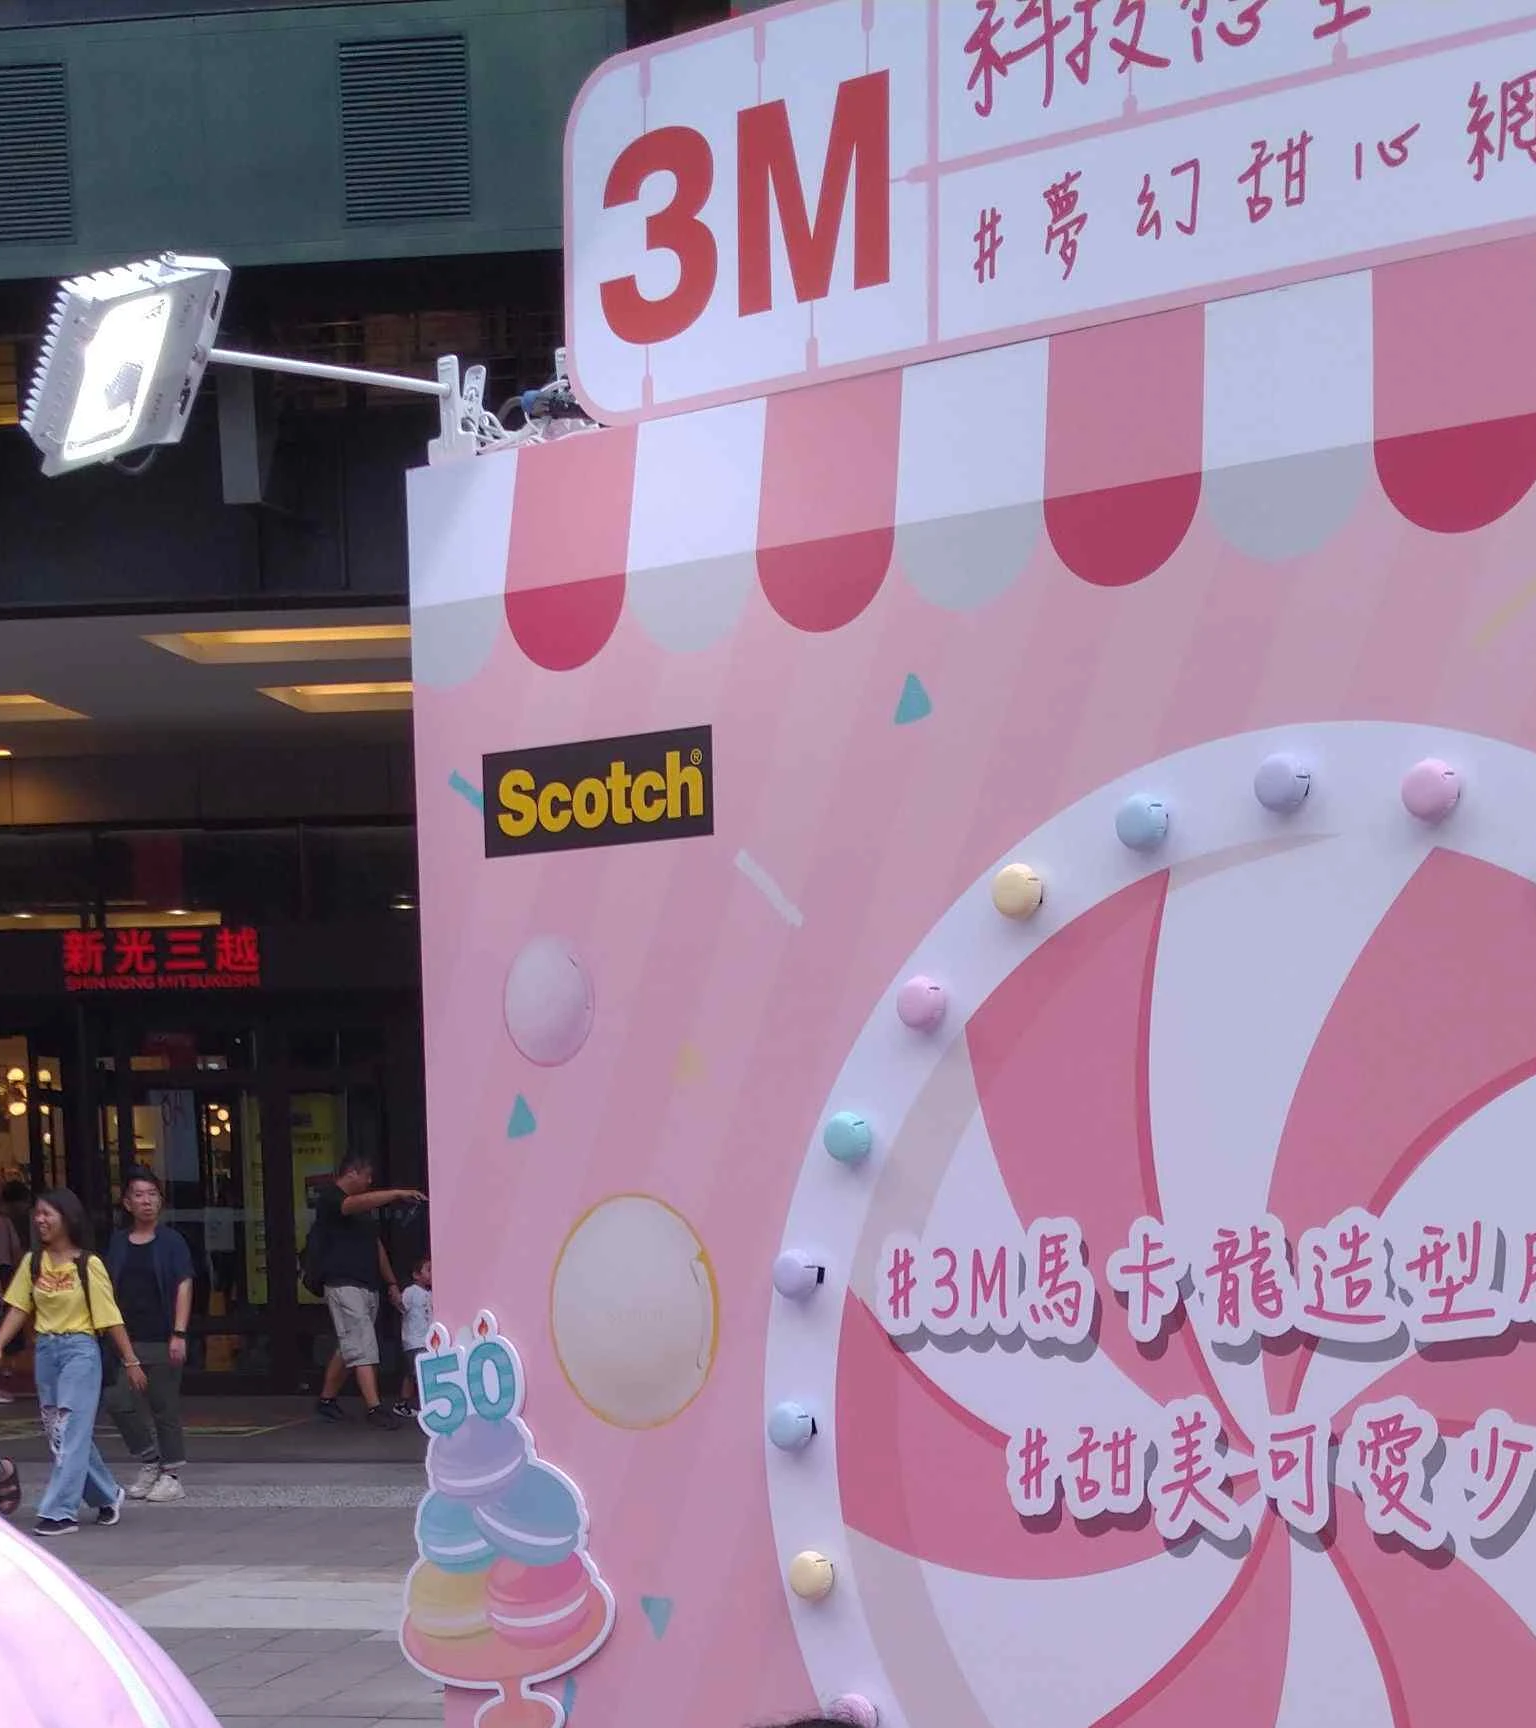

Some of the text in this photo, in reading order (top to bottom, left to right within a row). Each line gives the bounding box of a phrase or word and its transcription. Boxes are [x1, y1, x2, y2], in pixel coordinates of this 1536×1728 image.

[597, 72, 892, 346] 3M
[496, 750, 704, 838] Scotch
[64, 927, 260, 974] 新光三越
[420, 1340, 516, 1436] 50
